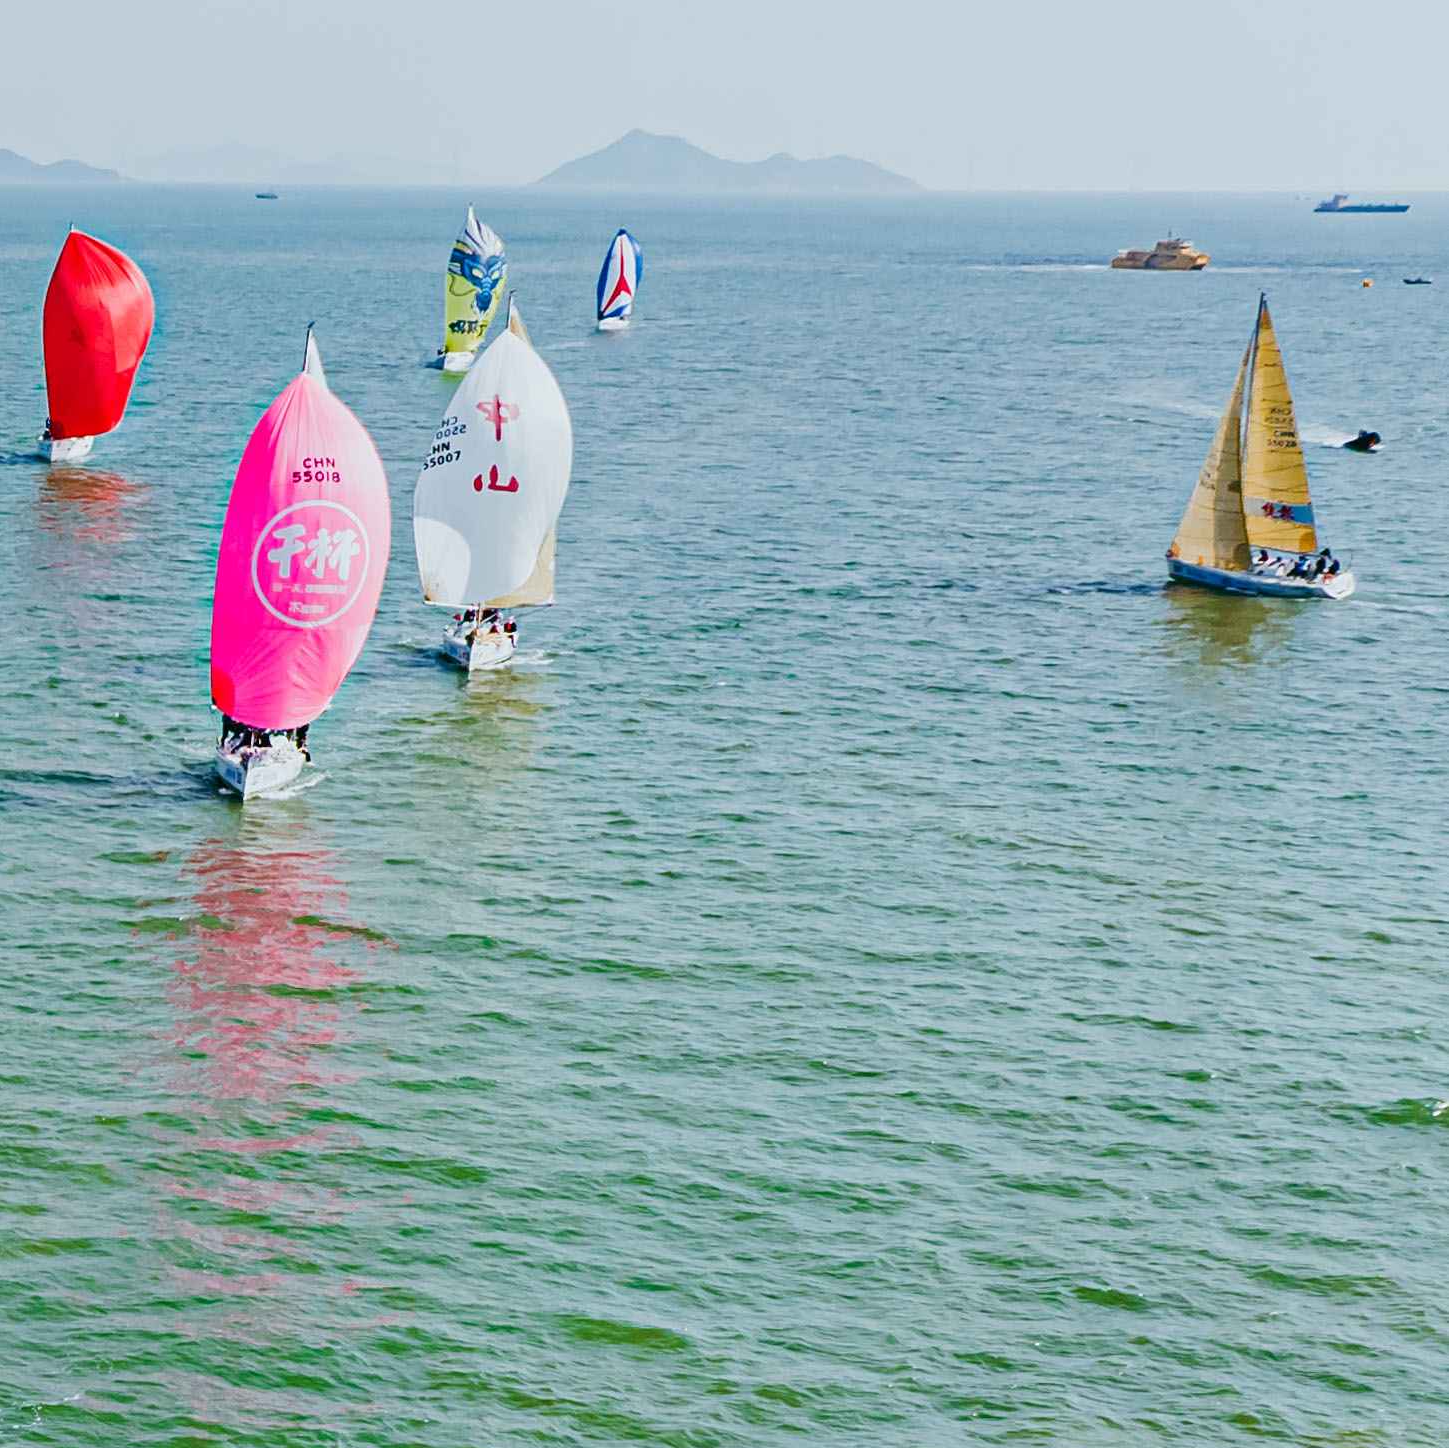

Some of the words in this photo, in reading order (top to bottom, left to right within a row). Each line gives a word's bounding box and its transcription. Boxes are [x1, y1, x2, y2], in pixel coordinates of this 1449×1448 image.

[426, 441, 451, 457] HN
[302, 457, 335, 468] CHN
[291, 471, 341, 483] 55018
[267, 523, 361, 581] 干杯
